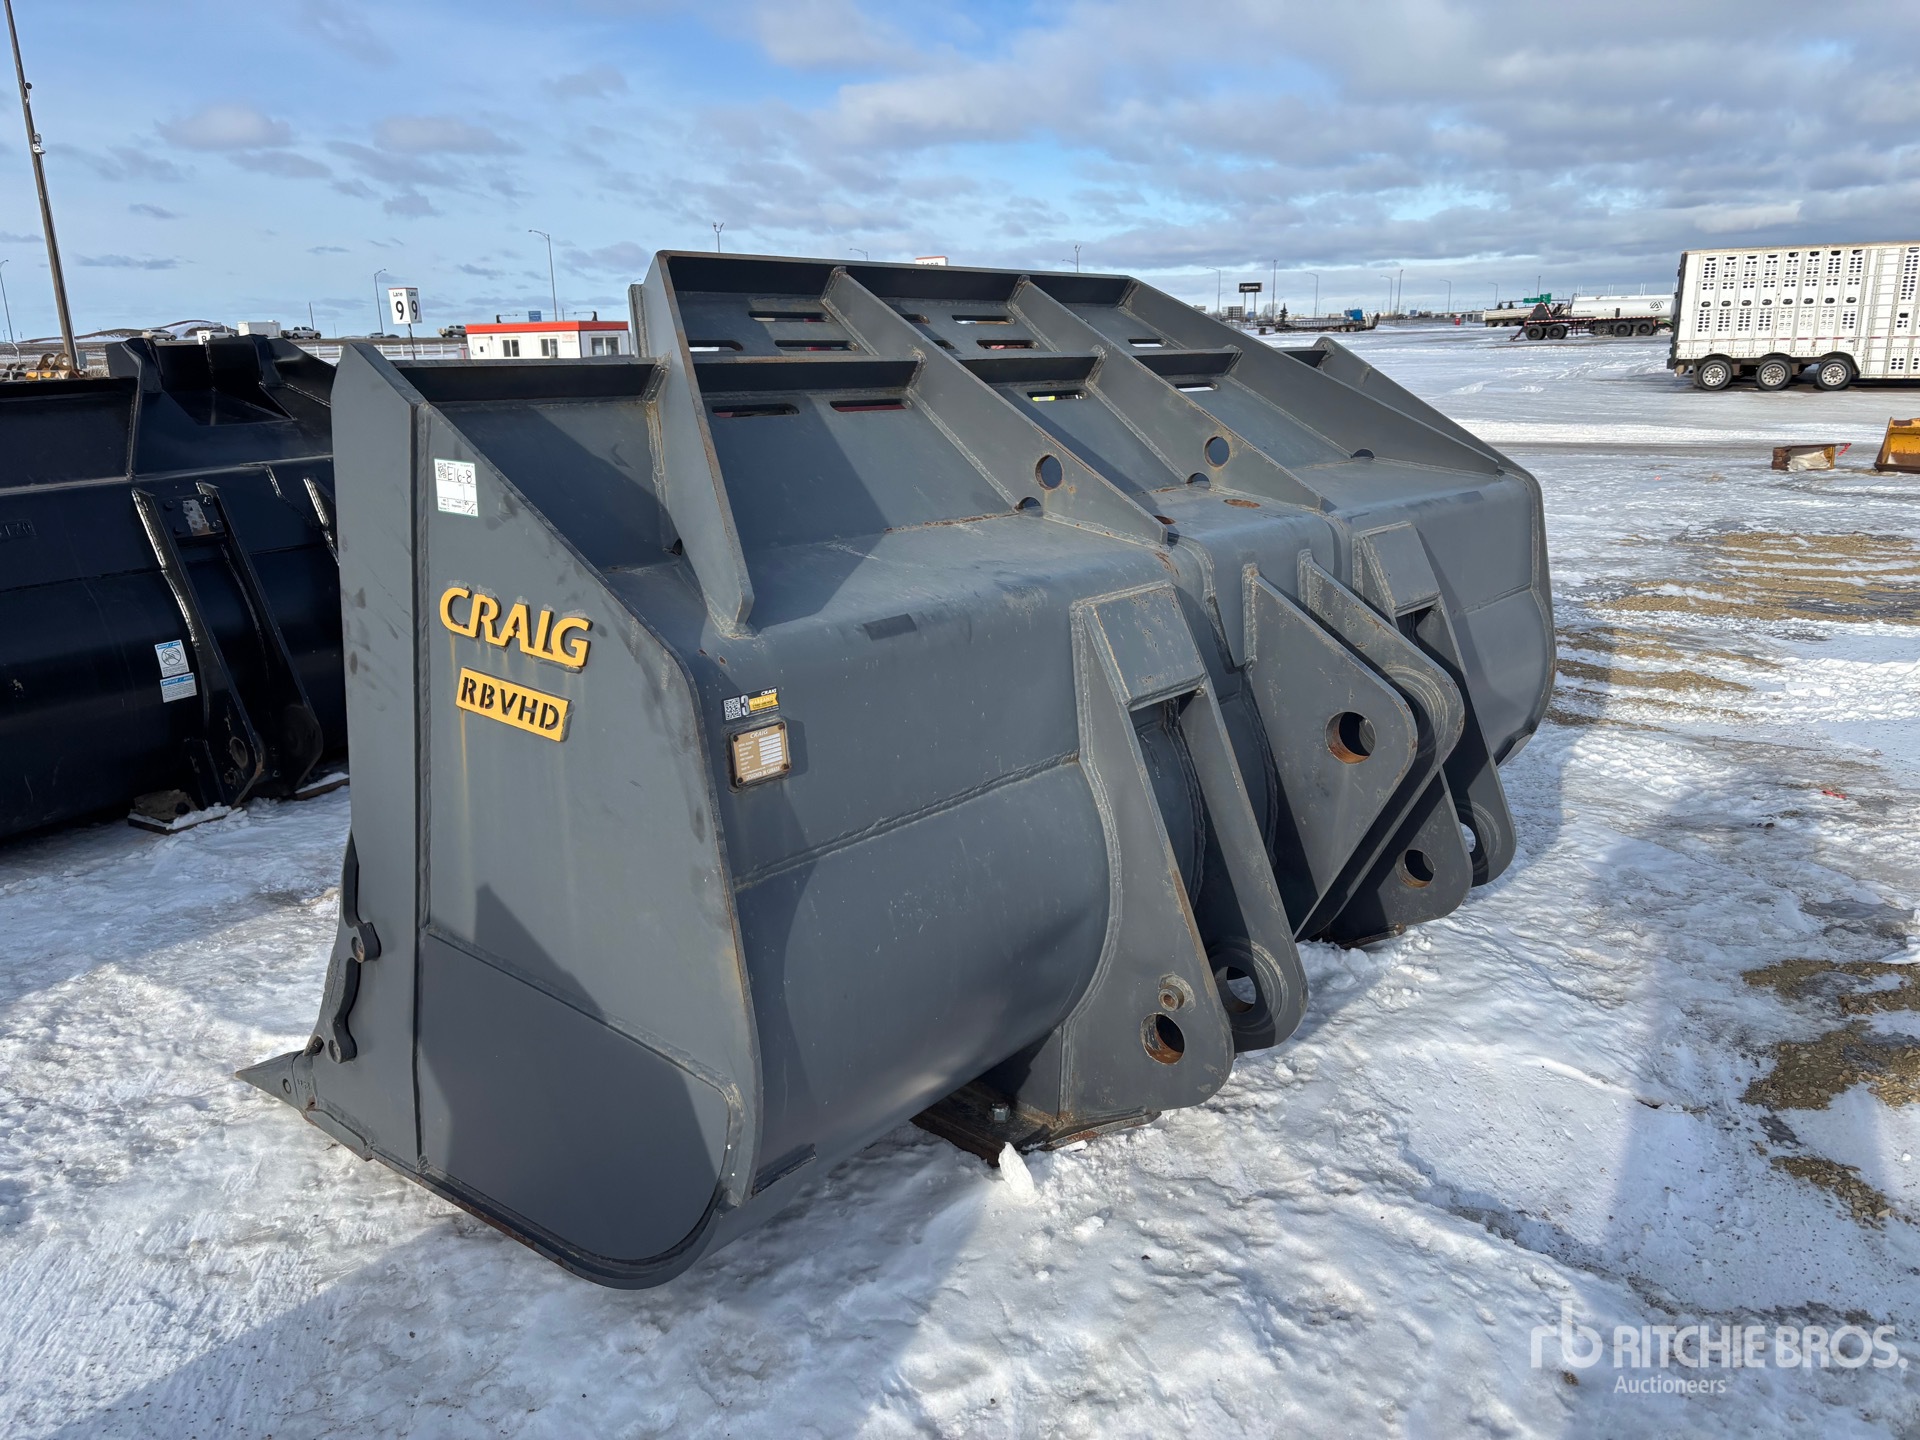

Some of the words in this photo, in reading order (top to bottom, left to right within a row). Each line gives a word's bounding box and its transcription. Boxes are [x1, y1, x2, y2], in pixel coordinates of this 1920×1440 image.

[395, 300, 404, 320] 9
[411, 300, 418, 320] 9
[439, 587, 592, 668] CRAIG
[761, 687, 776, 696] CRAIG
[461, 677, 559, 730] RBVHD
[740, 695, 750, 716] 3
[750, 729, 768, 739] CRAIG
